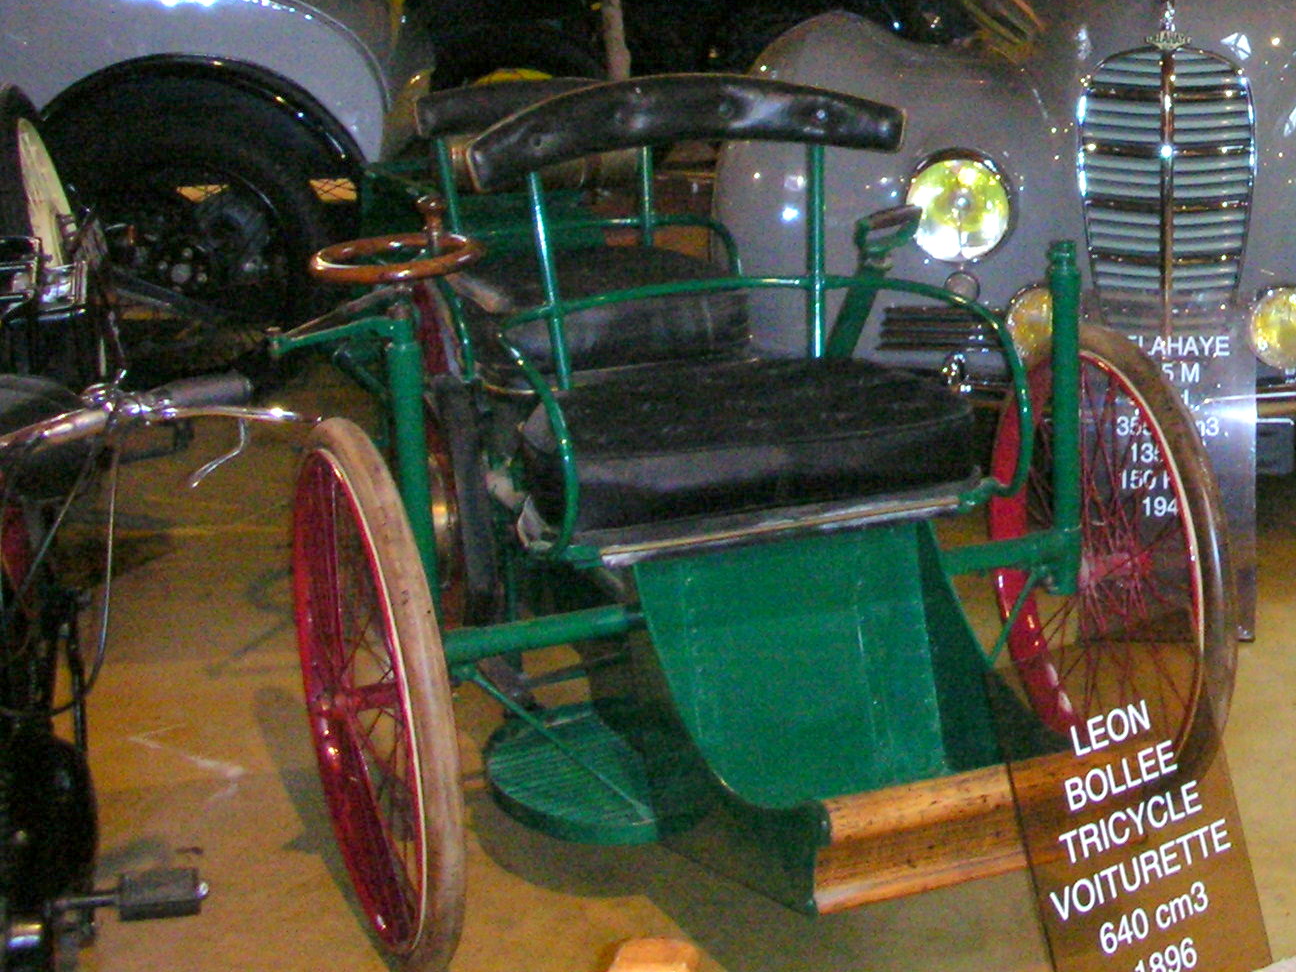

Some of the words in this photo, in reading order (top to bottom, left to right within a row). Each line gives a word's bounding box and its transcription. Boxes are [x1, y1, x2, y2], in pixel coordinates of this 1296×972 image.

[1127, 335, 1230, 357] LAHAYE
[1180, 362, 1200, 383] M
[1142, 496, 1178, 517] 194
[1070, 699, 1151, 756] LEON
[1064, 739, 1178, 811] BOLLEE
[1058, 780, 1203, 864] TRICYCLE
[1049, 818, 1232, 921] VOITURETTE
[1100, 908, 1150, 954] 640
[1155, 881, 1209, 928] cm3
